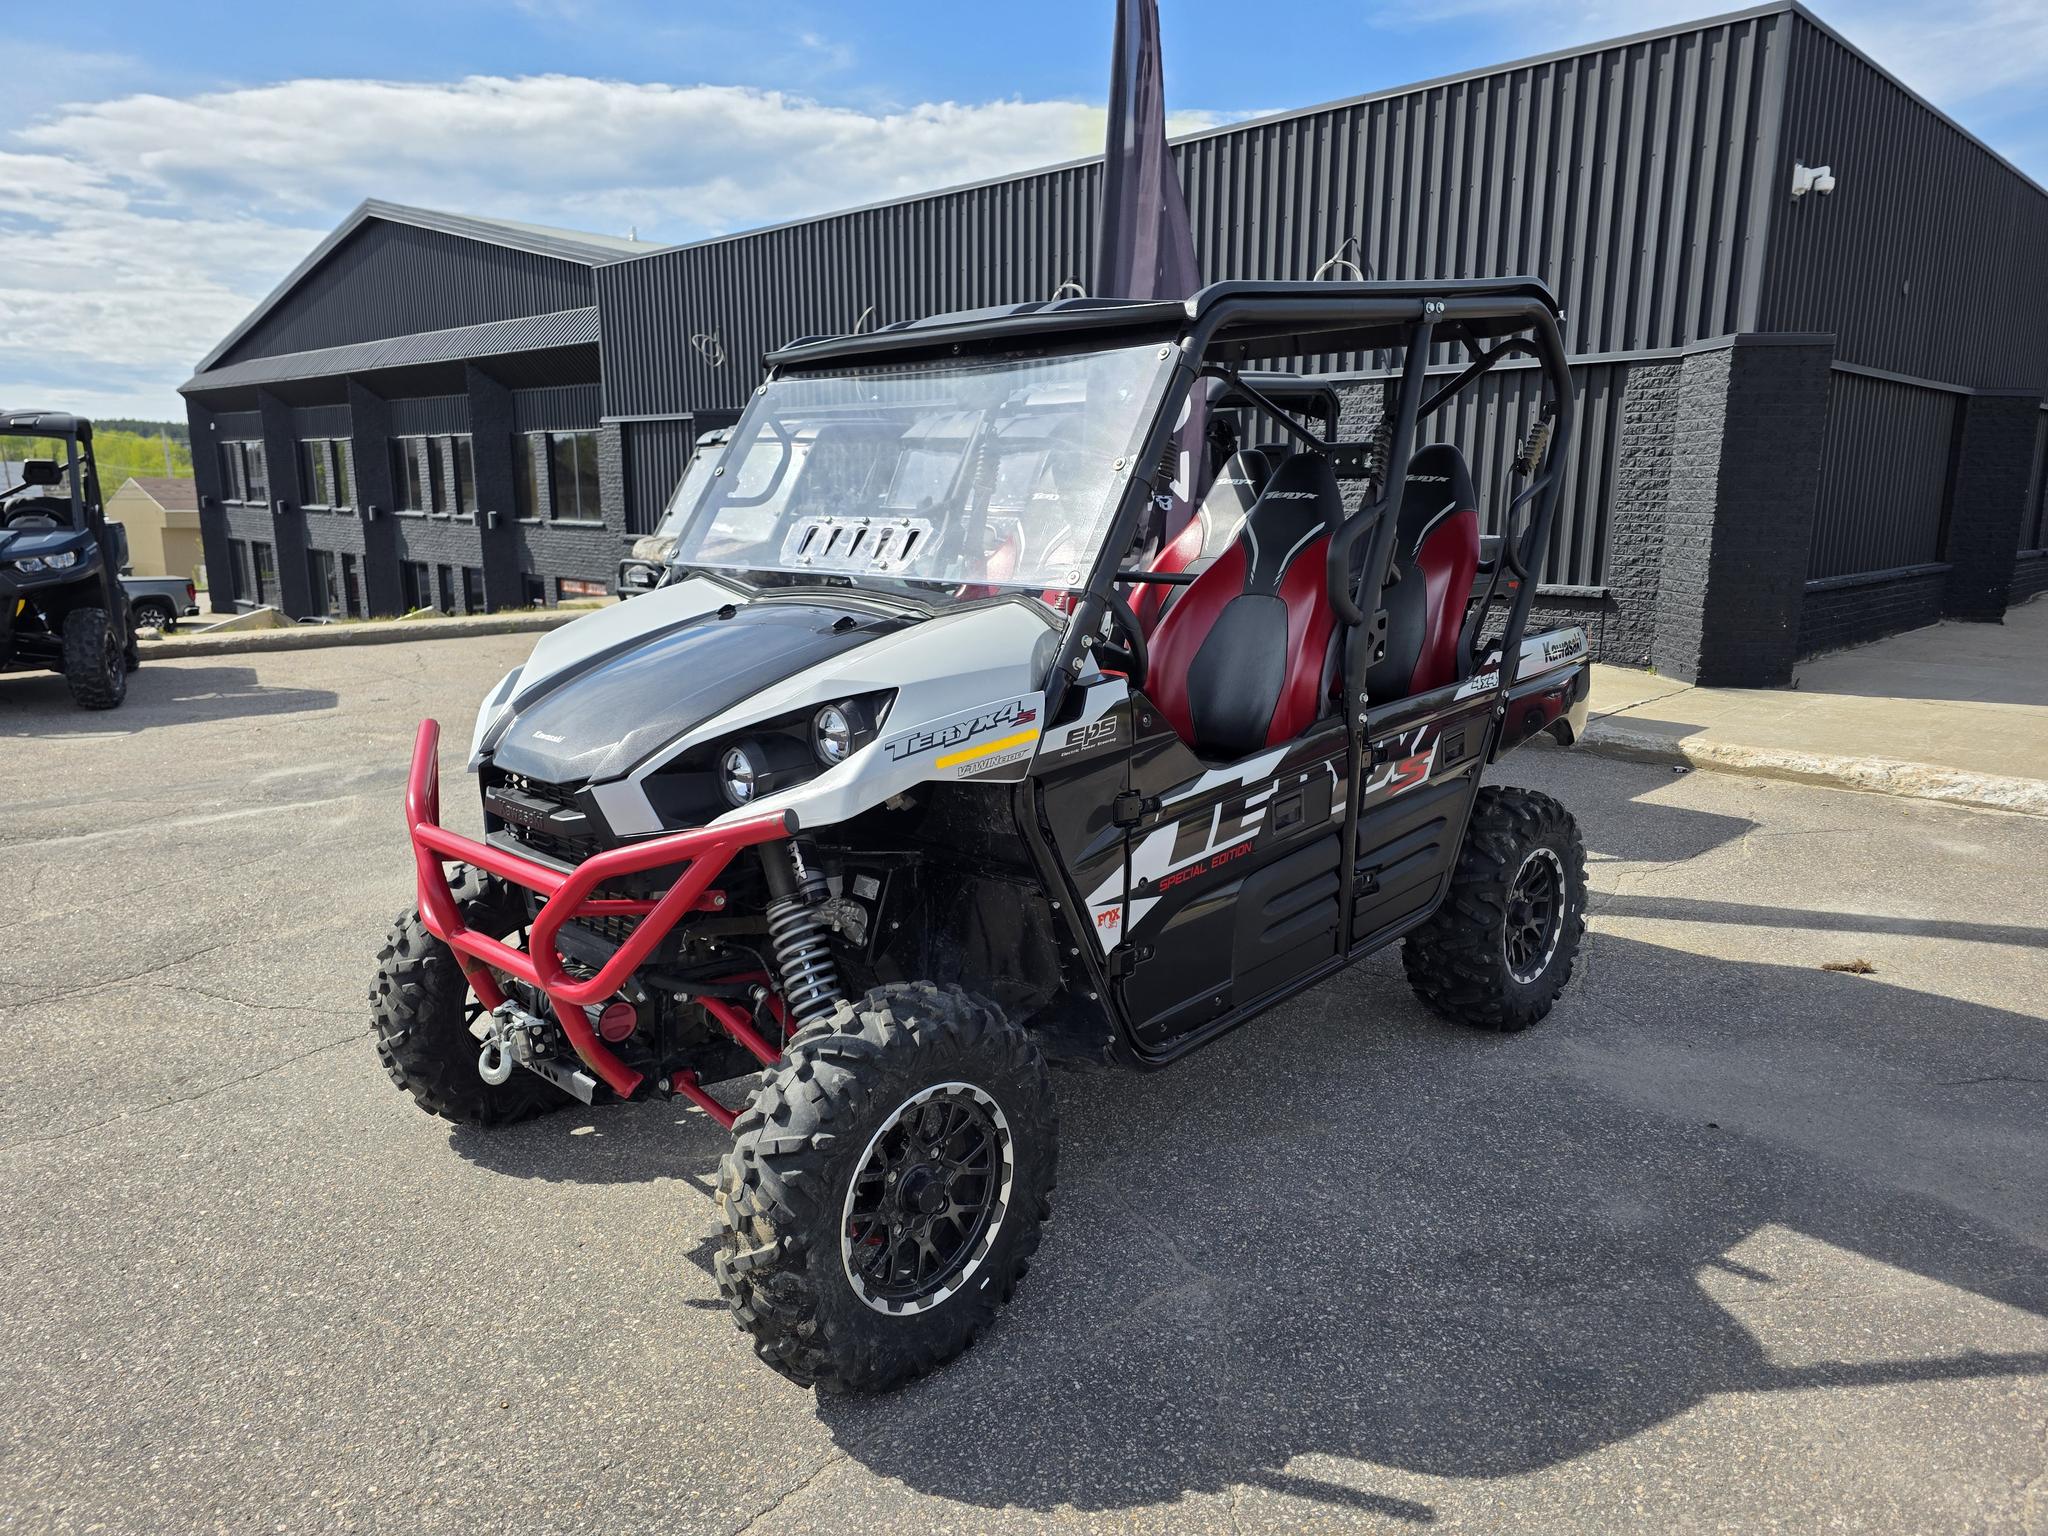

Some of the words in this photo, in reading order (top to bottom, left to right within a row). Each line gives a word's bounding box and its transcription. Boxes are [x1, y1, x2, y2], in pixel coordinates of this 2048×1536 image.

[1542, 632, 1582, 663] Kawasaki
[1065, 715, 1118, 748] EPS
[787, 840, 808, 883] FOX
[1159, 863, 1207, 892] SPECIAL
[1211, 840, 1253, 868] EDITION
[1097, 906, 1121, 929] FOX
